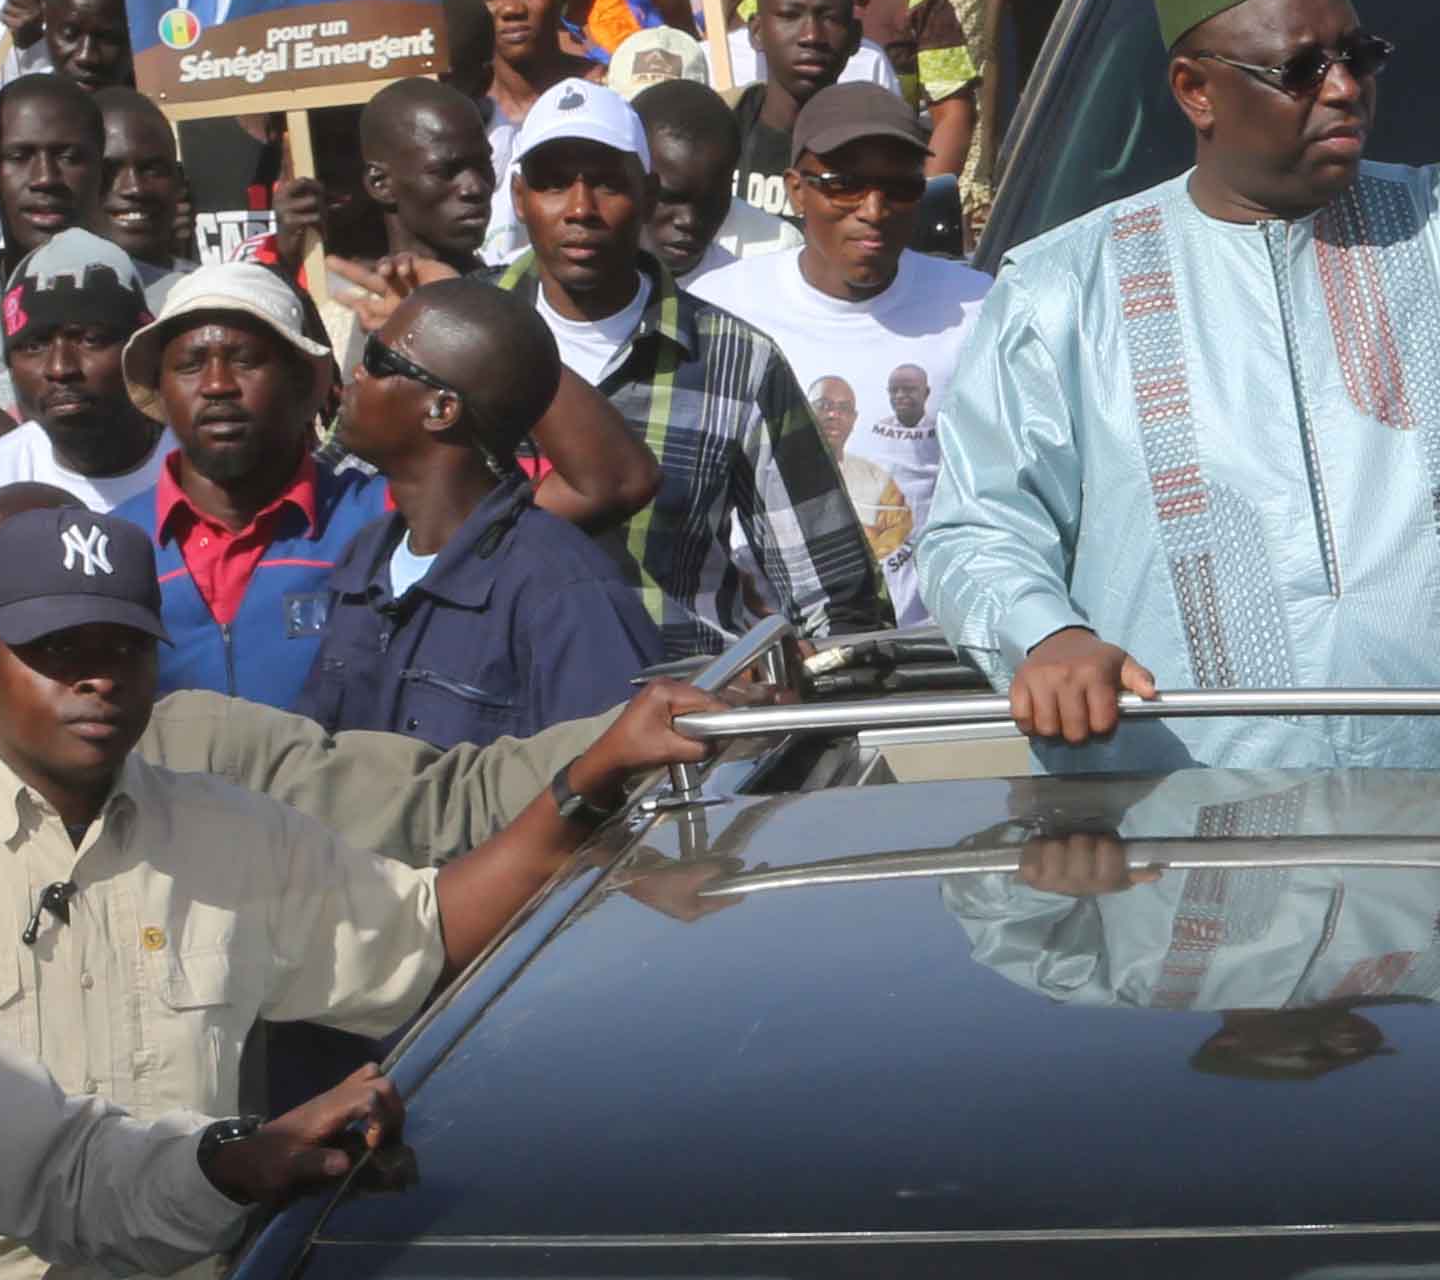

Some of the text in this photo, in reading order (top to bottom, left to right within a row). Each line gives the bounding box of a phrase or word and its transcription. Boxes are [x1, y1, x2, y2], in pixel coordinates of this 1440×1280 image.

[266, 18, 349, 49] pour un
[179, 26, 436, 86] Sénégal Emergent
[871, 422, 924, 442] MATAR
